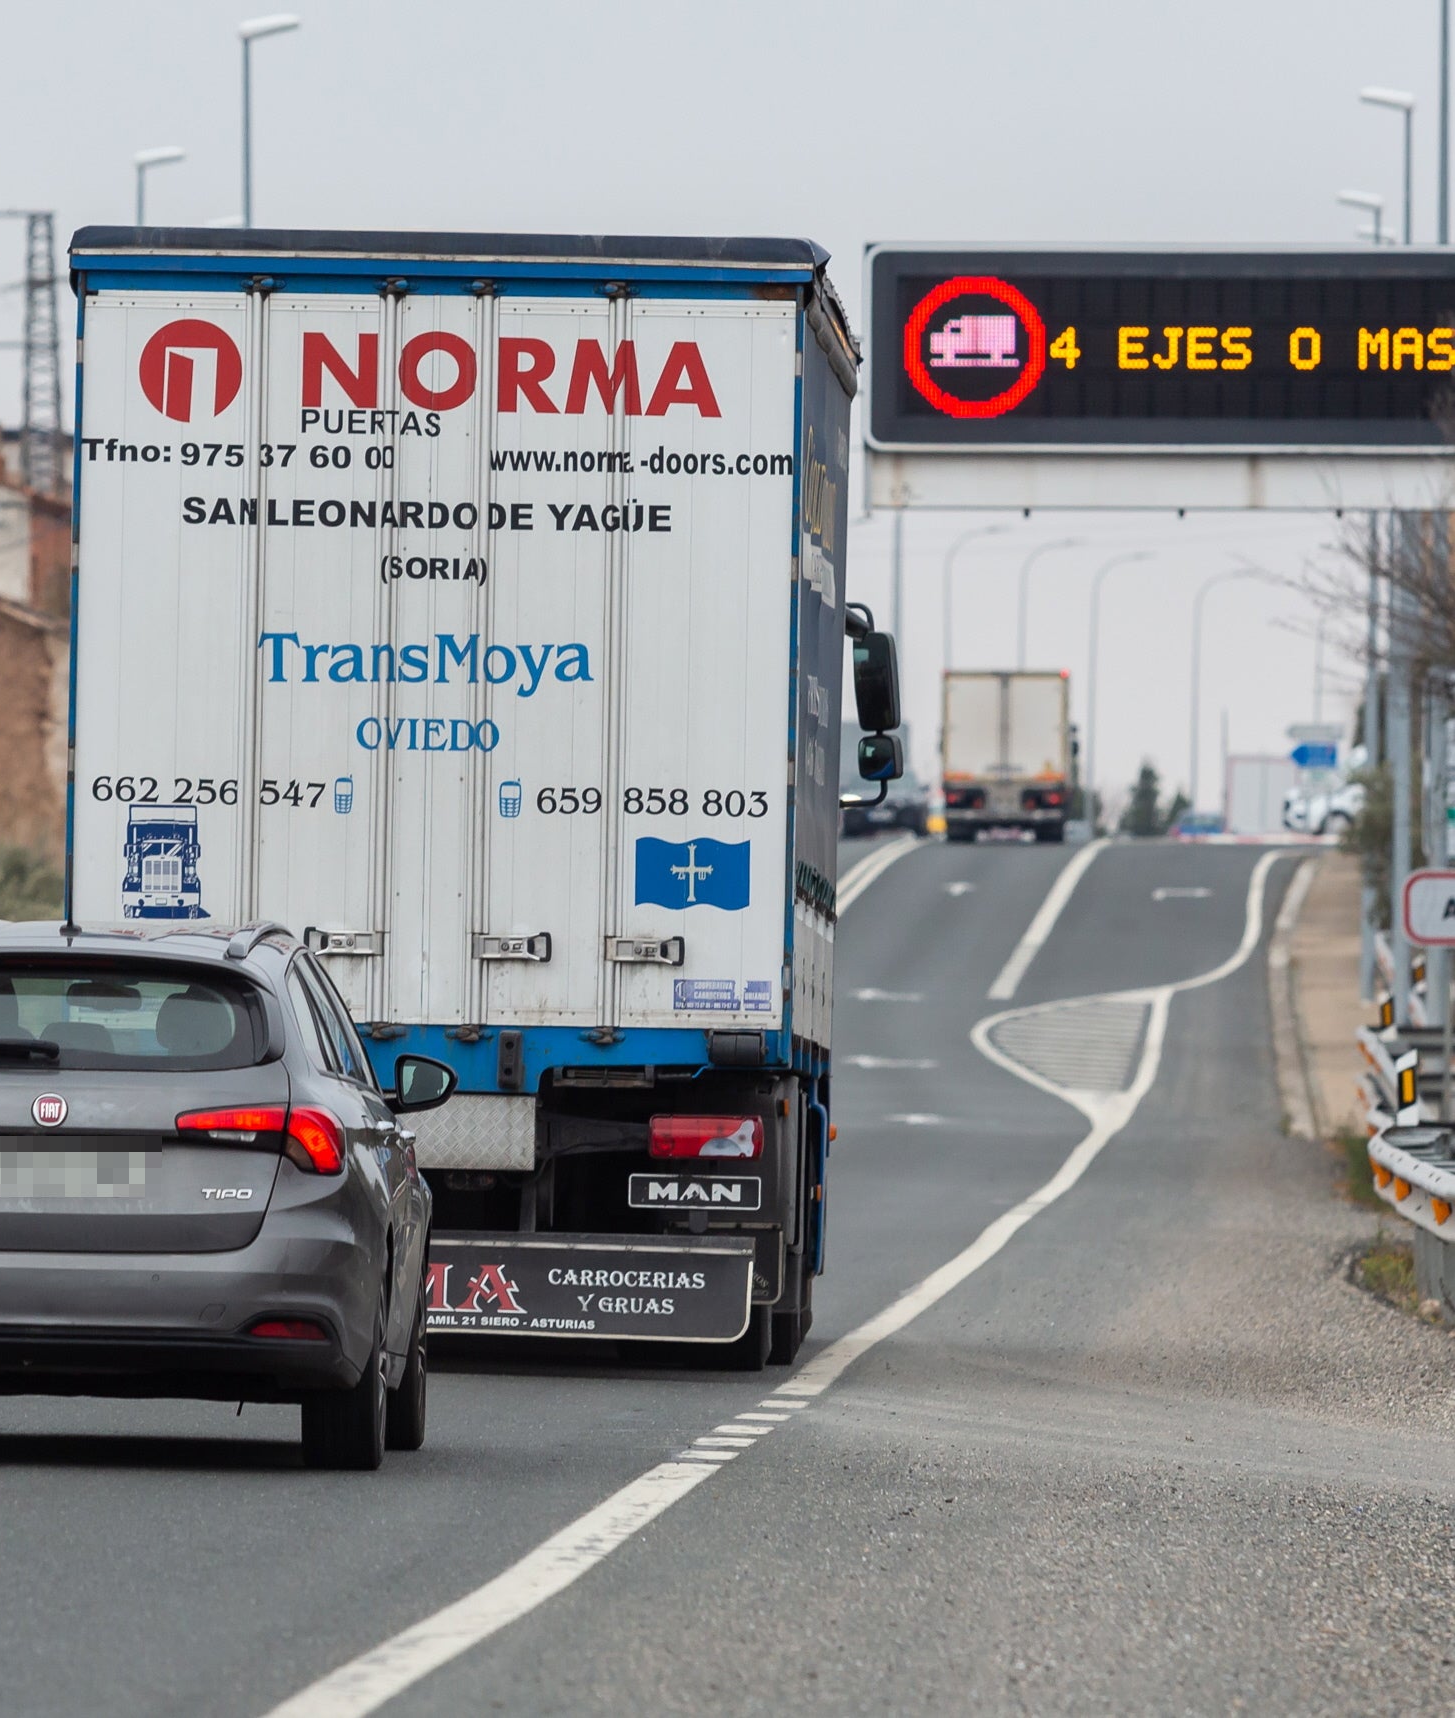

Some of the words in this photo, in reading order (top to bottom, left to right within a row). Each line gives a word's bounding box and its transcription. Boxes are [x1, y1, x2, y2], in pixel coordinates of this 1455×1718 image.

[1049, 325, 1081, 370] 4
[1118, 325, 1253, 371] EJES
[1358, 326, 1455, 372] MAS
[301, 331, 722, 418] NORMA
[301, 409, 442, 437] PUERTAS
[81, 438, 171, 463] Tfno:
[180, 442, 244, 467] 975
[259, 444, 297, 468] 37
[309, 446, 351, 469] 60
[364, 446, 394, 470] 00
[182, 496, 258, 525] SAN
[267, 500, 478, 530] LEONARDO
[488, 502, 533, 530] DE
[547, 498, 672, 532] YAGÜE
[380, 555, 488, 586] (SORIA)
[258, 631, 594, 698] TransMoya
[355, 717, 501, 753] OVIEDO
[92, 776, 159, 803] 662
[172, 779, 239, 806] 256
[259, 780, 326, 808] 547
[536, 787, 602, 815] 659
[623, 787, 689, 816] 858
[702, 789, 769, 818] 803
[40, 1102, 61, 1119] FIAT
[201, 1188, 253, 1200] TIPO
[648, 1181, 742, 1203] MAN
[547, 1268, 706, 1290] CARROCERIAS
[577, 1293, 595, 1312] Y
[598, 1296, 675, 1315] GRUAS
[461, 1316, 477, 1326] 21
[480, 1317, 520, 1327] SIERO
[529, 1318, 596, 1330] ASTURIAS
